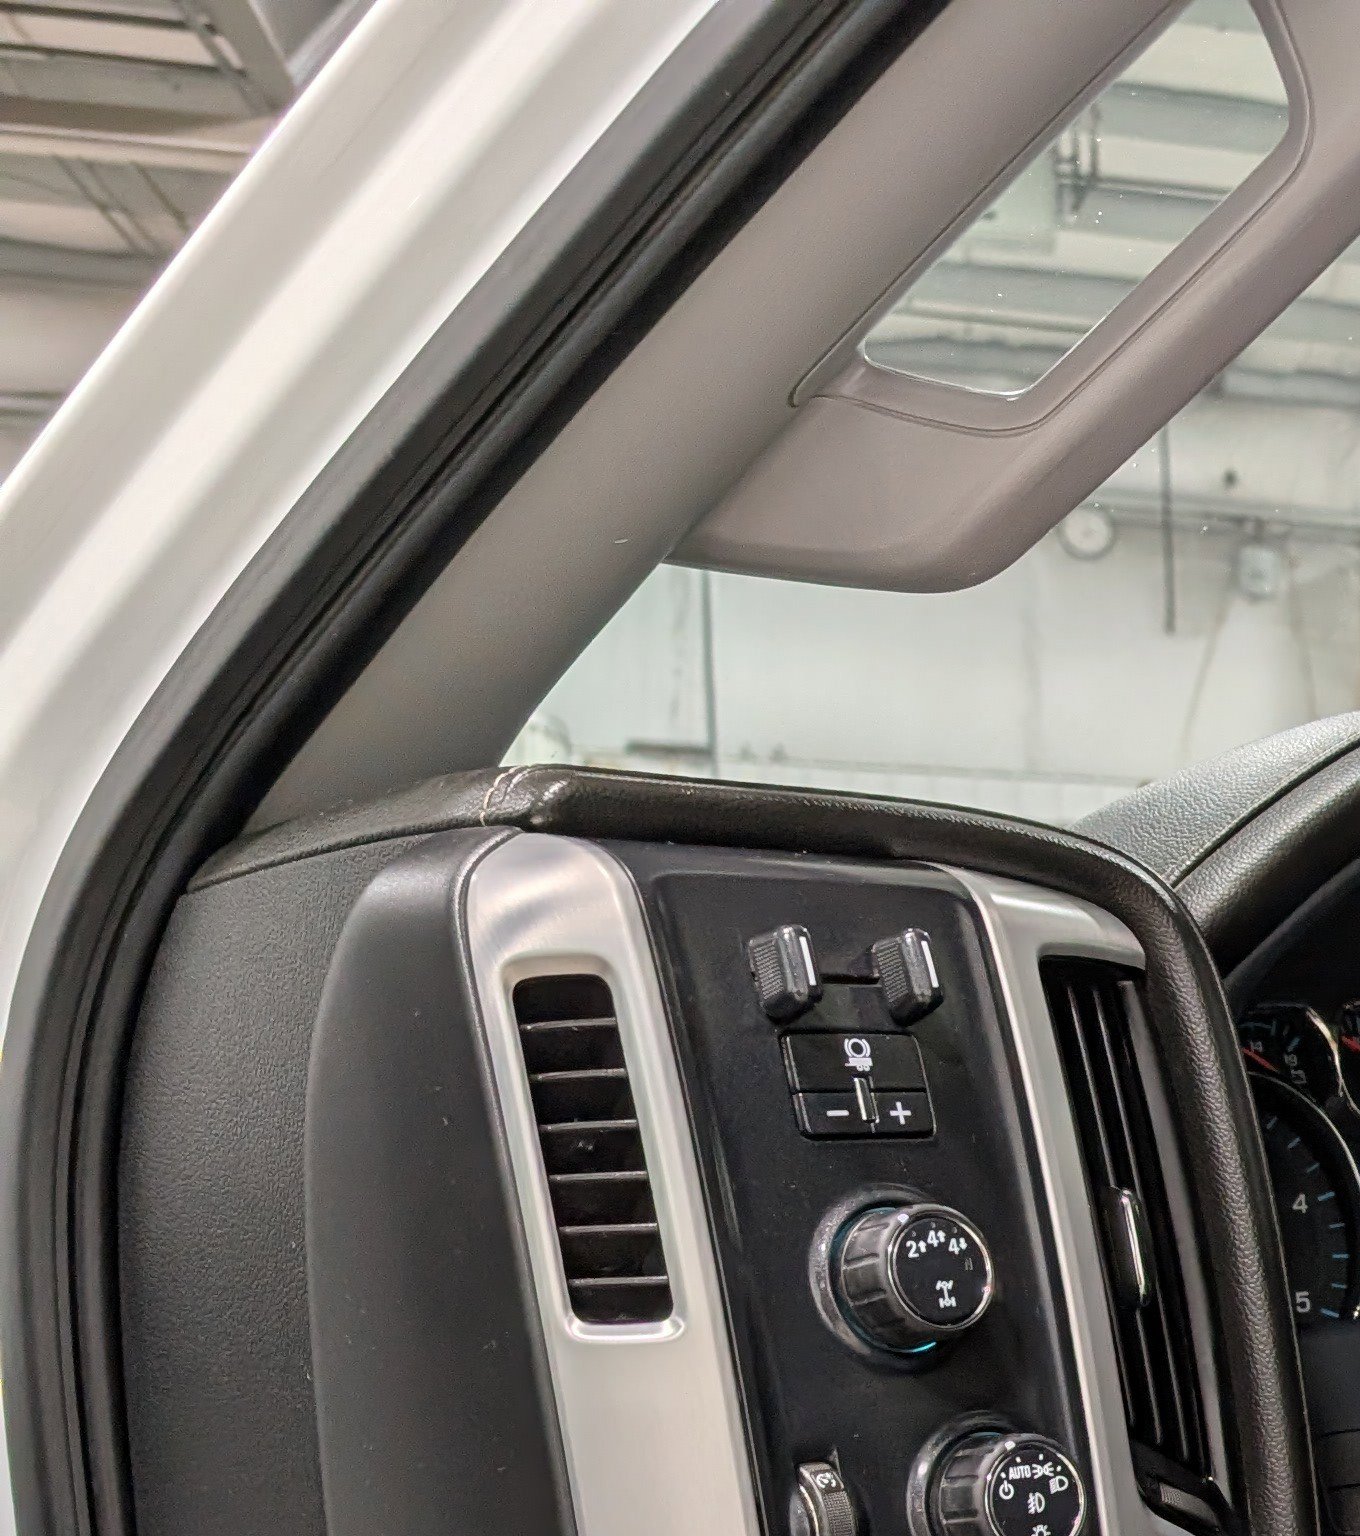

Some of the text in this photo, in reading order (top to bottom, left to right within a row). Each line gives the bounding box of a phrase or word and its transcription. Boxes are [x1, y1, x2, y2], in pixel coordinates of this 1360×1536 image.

[1292, 1193, 1308, 1214] 4
[1295, 1291, 1311, 1313] 5
[1008, 1464, 1032, 1480] AUTO
